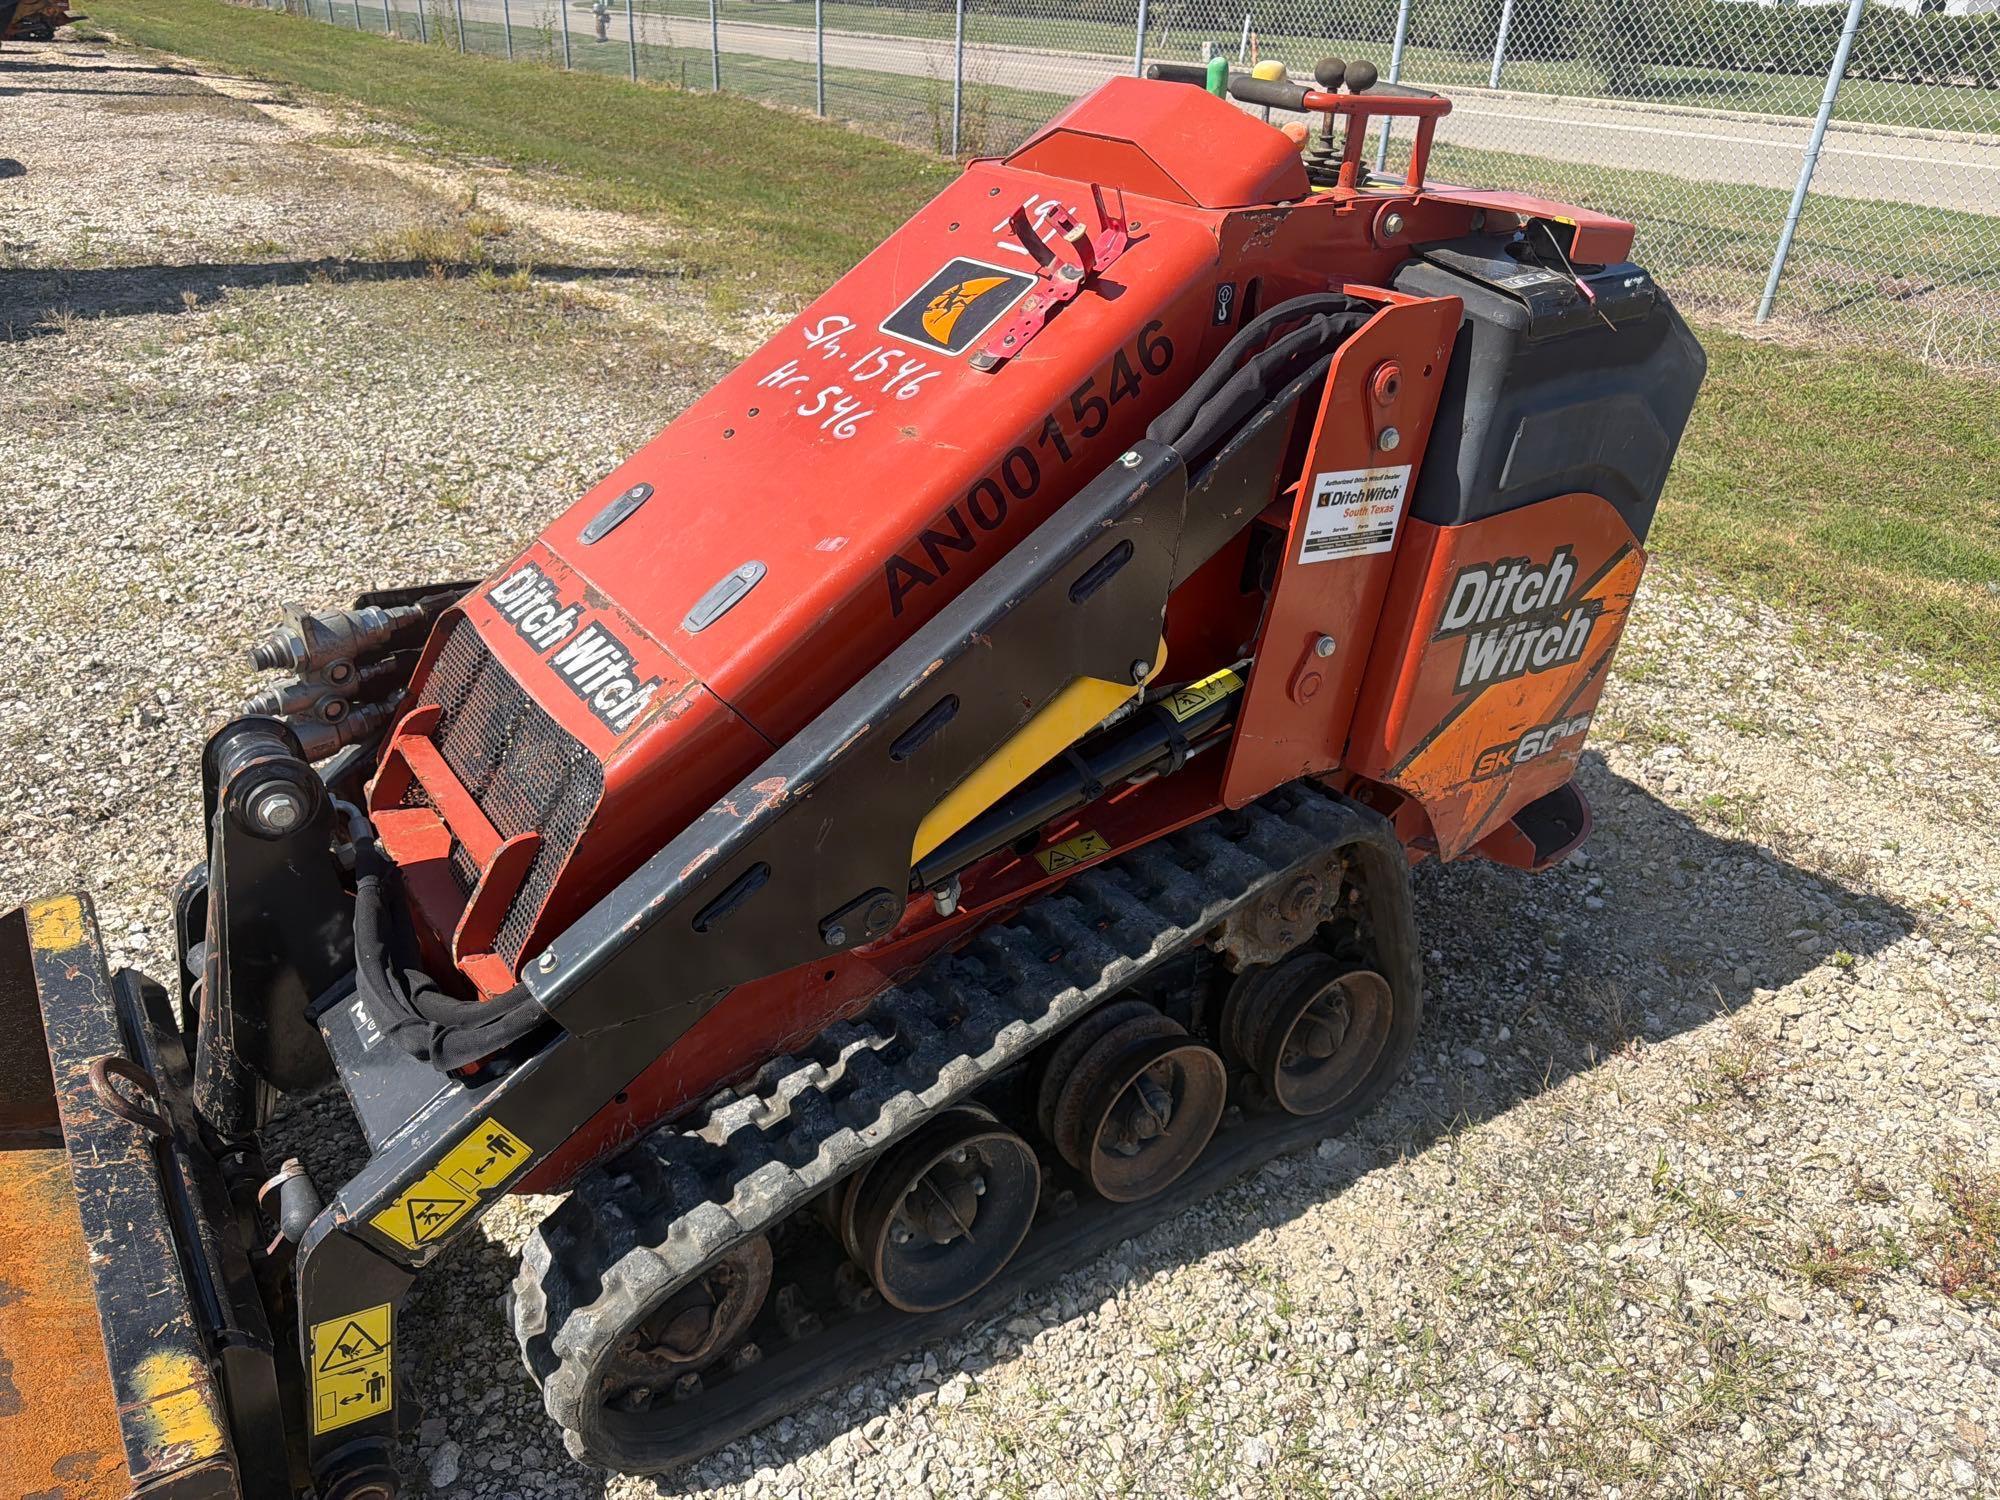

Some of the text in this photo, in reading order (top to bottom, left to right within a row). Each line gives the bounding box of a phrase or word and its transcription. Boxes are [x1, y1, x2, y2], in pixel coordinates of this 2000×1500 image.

[848, 346, 942, 400] 1546
[797, 386, 875, 439] 546
[884, 319, 1175, 618] AN001546
[1343, 504, 1395, 518] South Texas
[1441, 553, 1574, 630] Ditch
[490, 566, 658, 729] Ditch Witch
[1459, 608, 1591, 687] Witch
